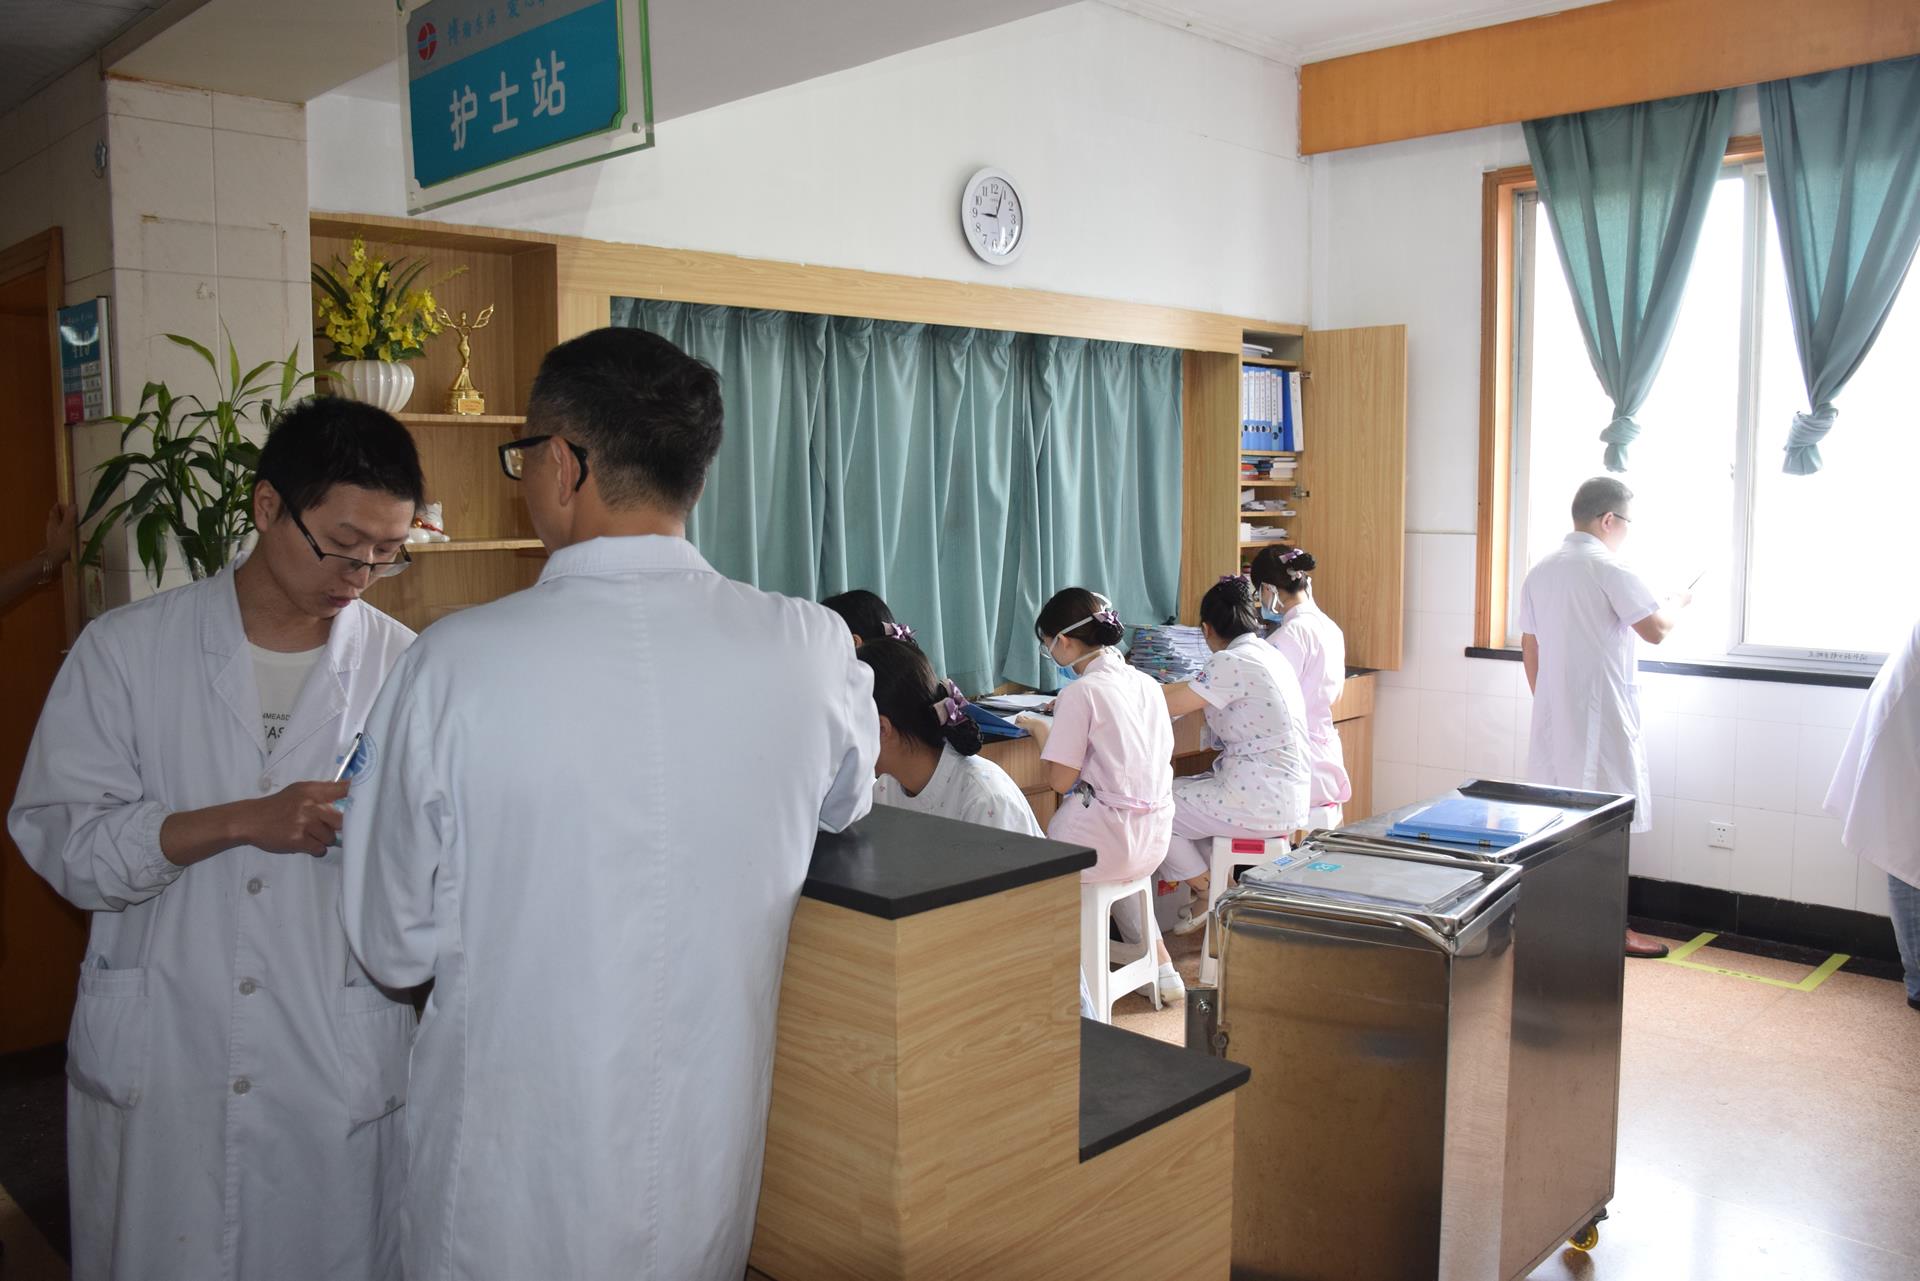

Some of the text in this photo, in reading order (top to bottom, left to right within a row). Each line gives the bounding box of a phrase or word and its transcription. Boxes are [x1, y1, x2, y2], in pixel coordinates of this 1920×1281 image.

[449, 50, 566, 151] 护士站
[982, 186, 988, 197] 11
[990, 184, 999, 195] 12
[975, 196, 983, 206] 10
[1008, 201, 1014, 212] 2
[972, 208, 978, 218] 9
[1010, 214, 1016, 225] 3
[975, 223, 982, 233] 8
[982, 234, 988, 245] 7
[1008, 229, 1014, 239] 4
[991, 239, 998, 249] 6
[264, 725, 285, 739] AS
